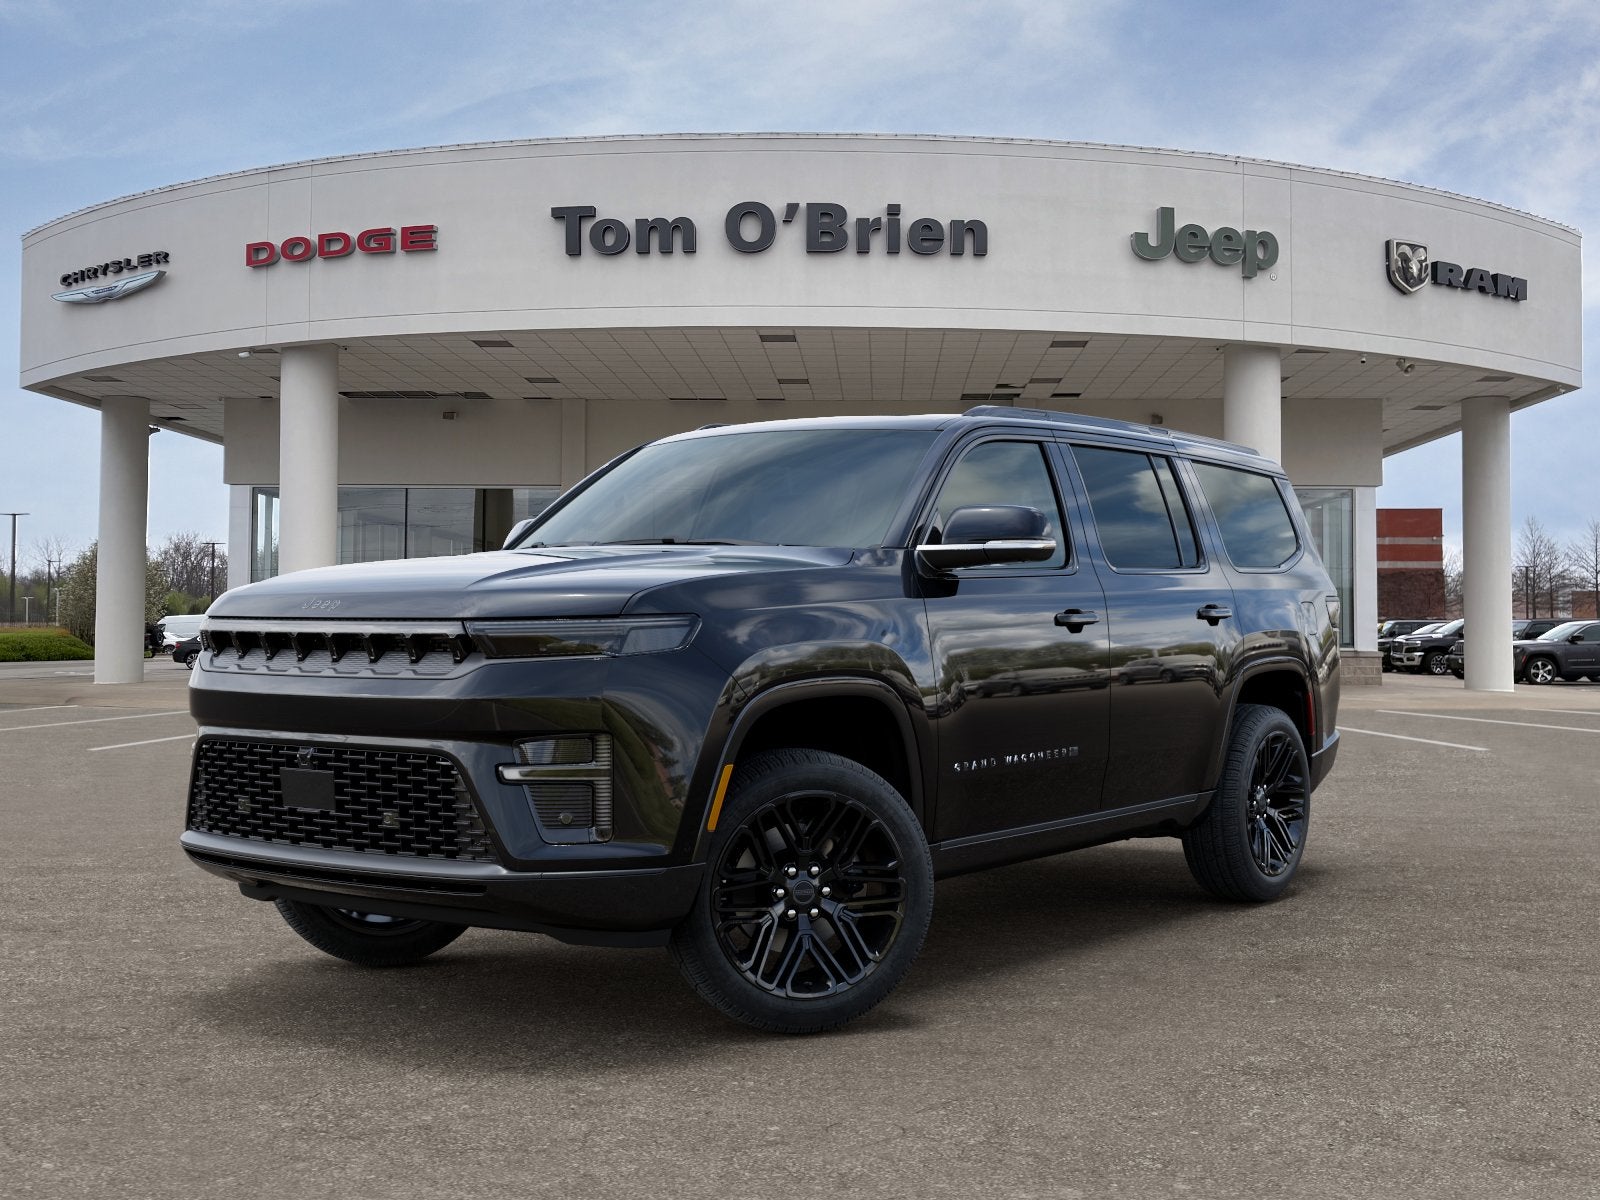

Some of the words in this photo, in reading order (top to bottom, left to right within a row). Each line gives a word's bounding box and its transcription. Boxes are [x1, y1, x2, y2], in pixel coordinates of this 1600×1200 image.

[245, 224, 438, 268] DODGE
[551, 206, 697, 256] Tom
[725, 201, 988, 256] O'Brien
[1130, 206, 1280, 279] Jeep
[60, 251, 170, 287] CHRYSLER
[1431, 260, 1528, 301] RAM
[302, 597, 341, 612] Jeep
